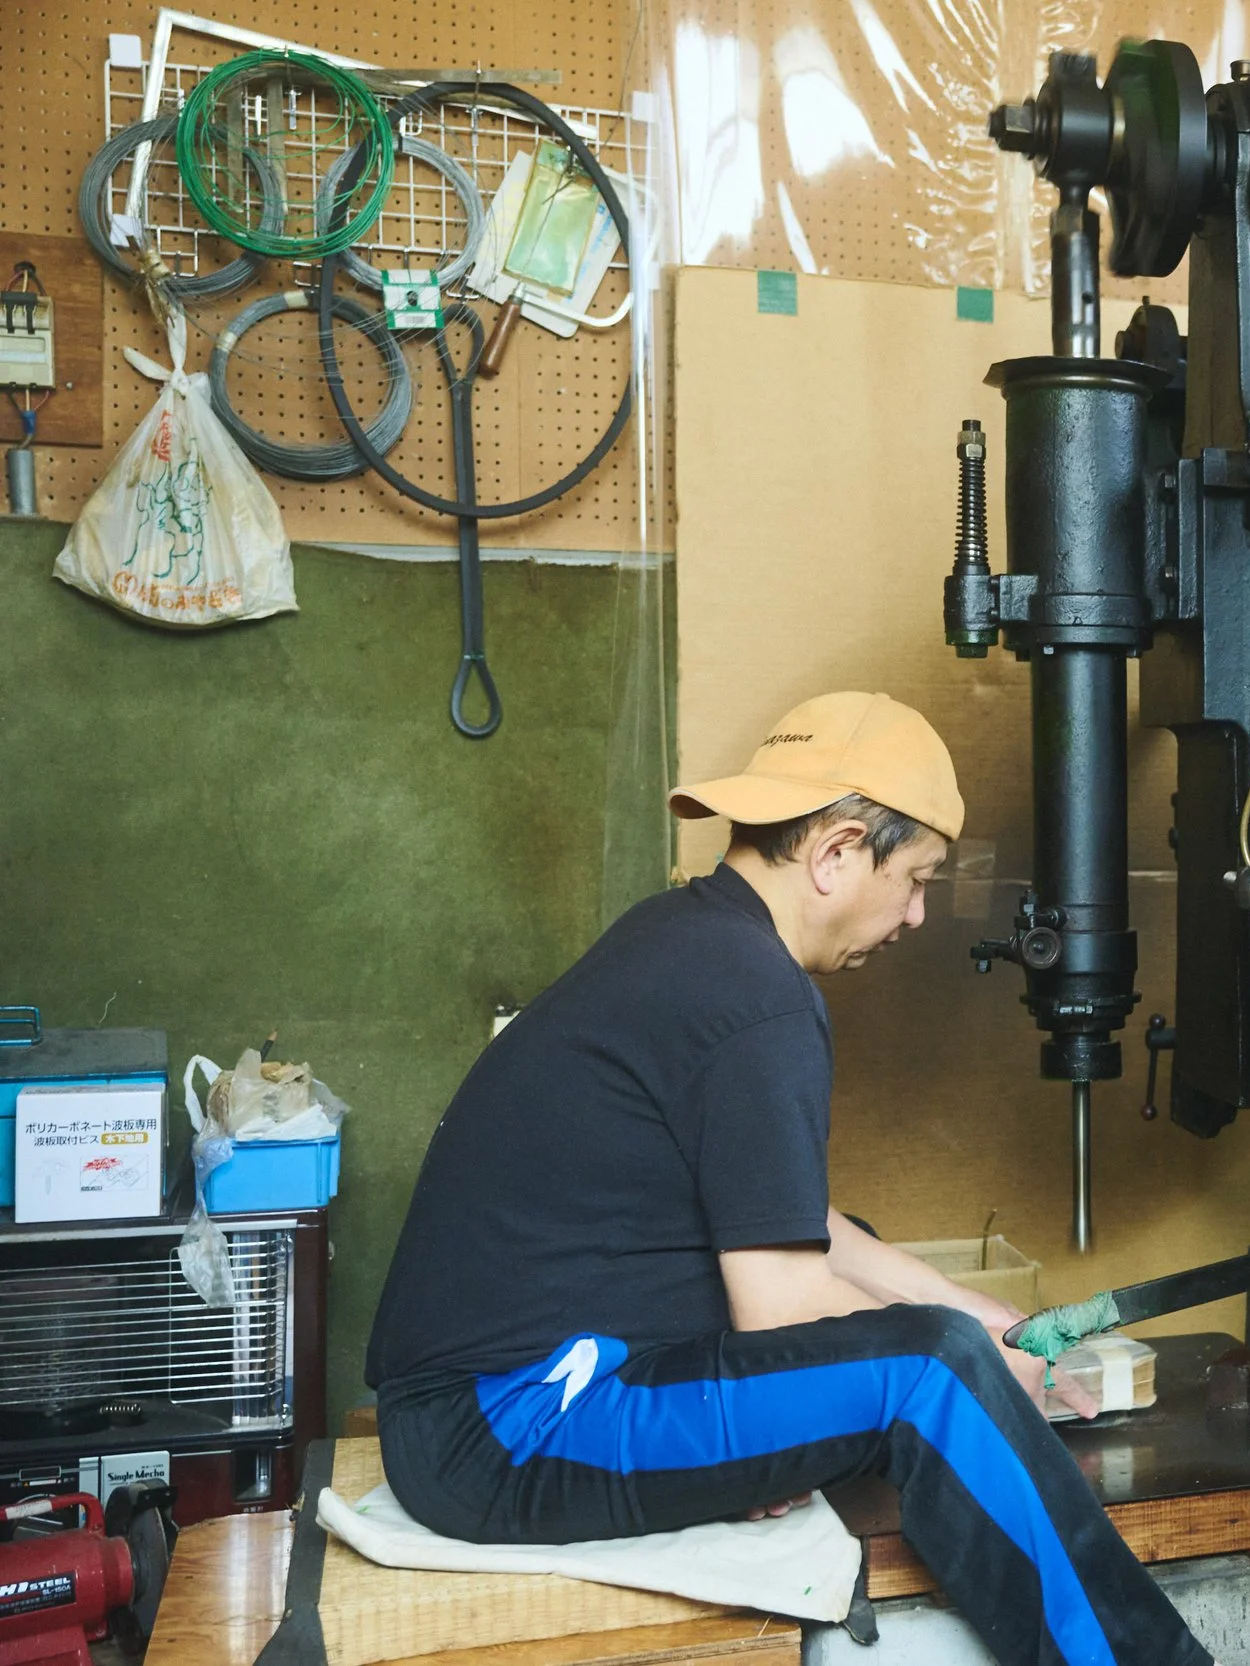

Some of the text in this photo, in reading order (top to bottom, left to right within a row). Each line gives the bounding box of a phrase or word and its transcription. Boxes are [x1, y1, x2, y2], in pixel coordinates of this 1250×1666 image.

[25, 1119, 157, 1134] ポリカーボネート波板専用
[34, 1135, 100, 1146] 波板取付ビス
[107, 1469, 165, 1482] Single Mecha
[29, 1577, 71, 1591] STEEL
